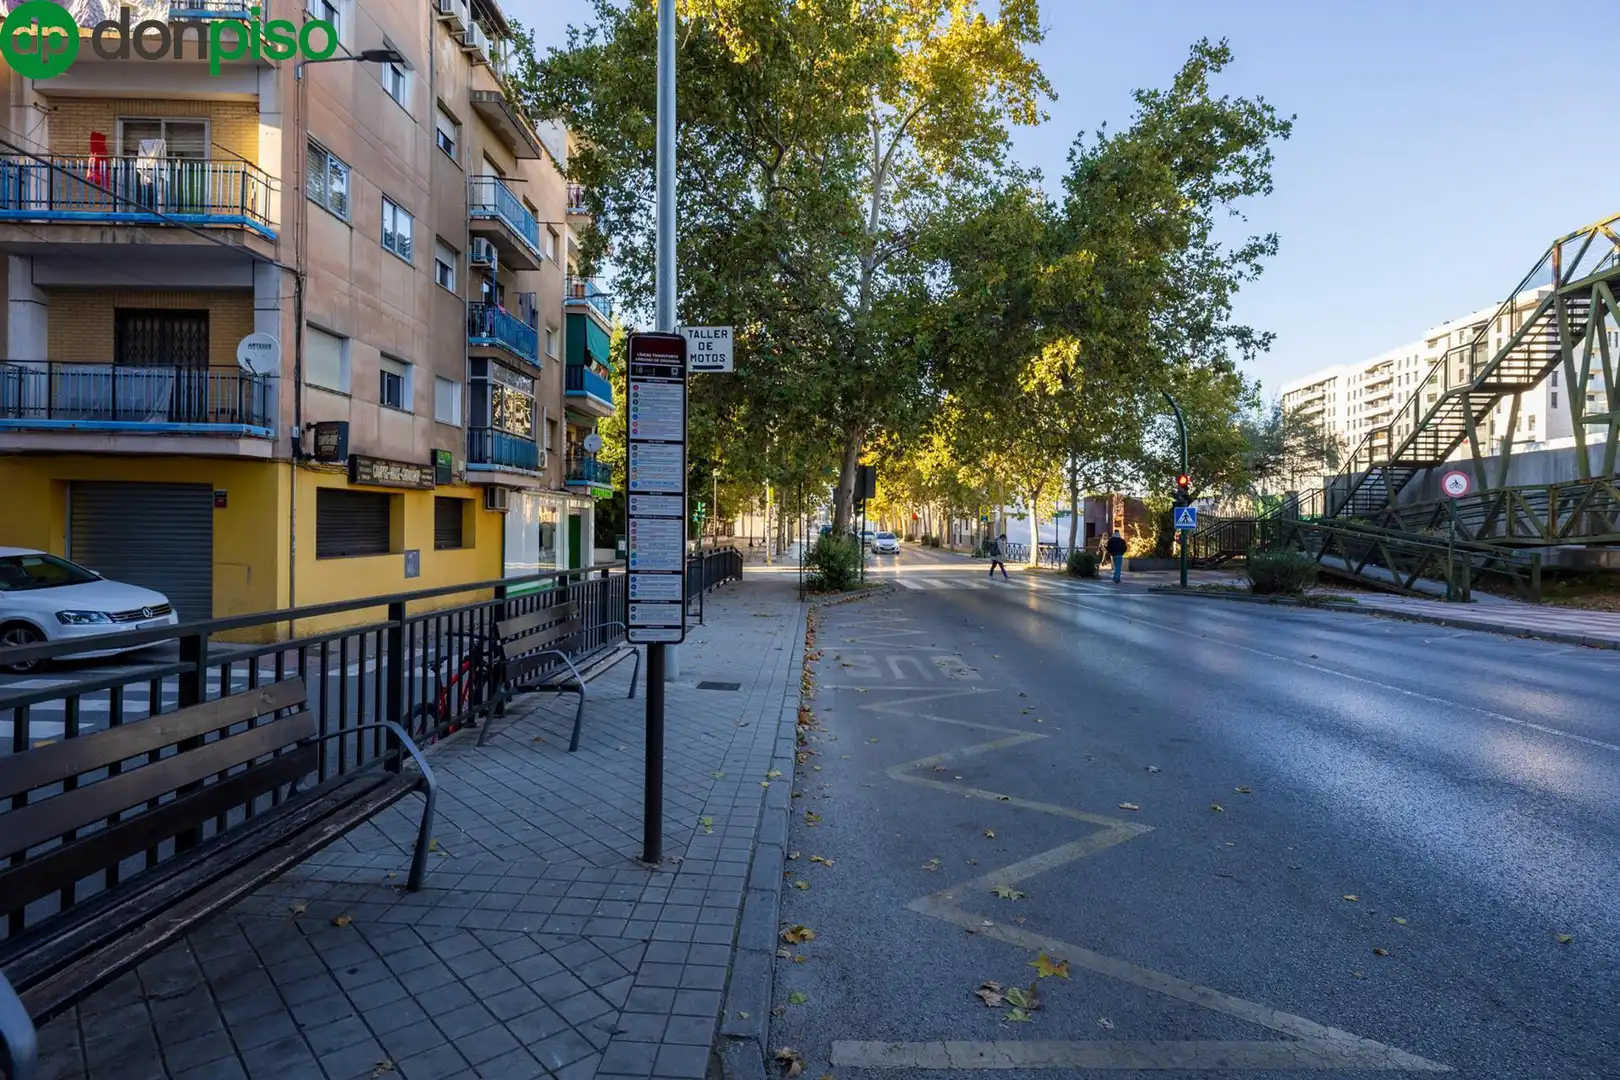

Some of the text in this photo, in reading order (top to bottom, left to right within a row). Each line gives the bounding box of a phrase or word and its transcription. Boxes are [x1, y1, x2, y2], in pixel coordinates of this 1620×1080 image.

[688, 329, 728, 338] TALLER
[698, 341, 713, 351] DE
[690, 353, 725, 363] MOTOS
